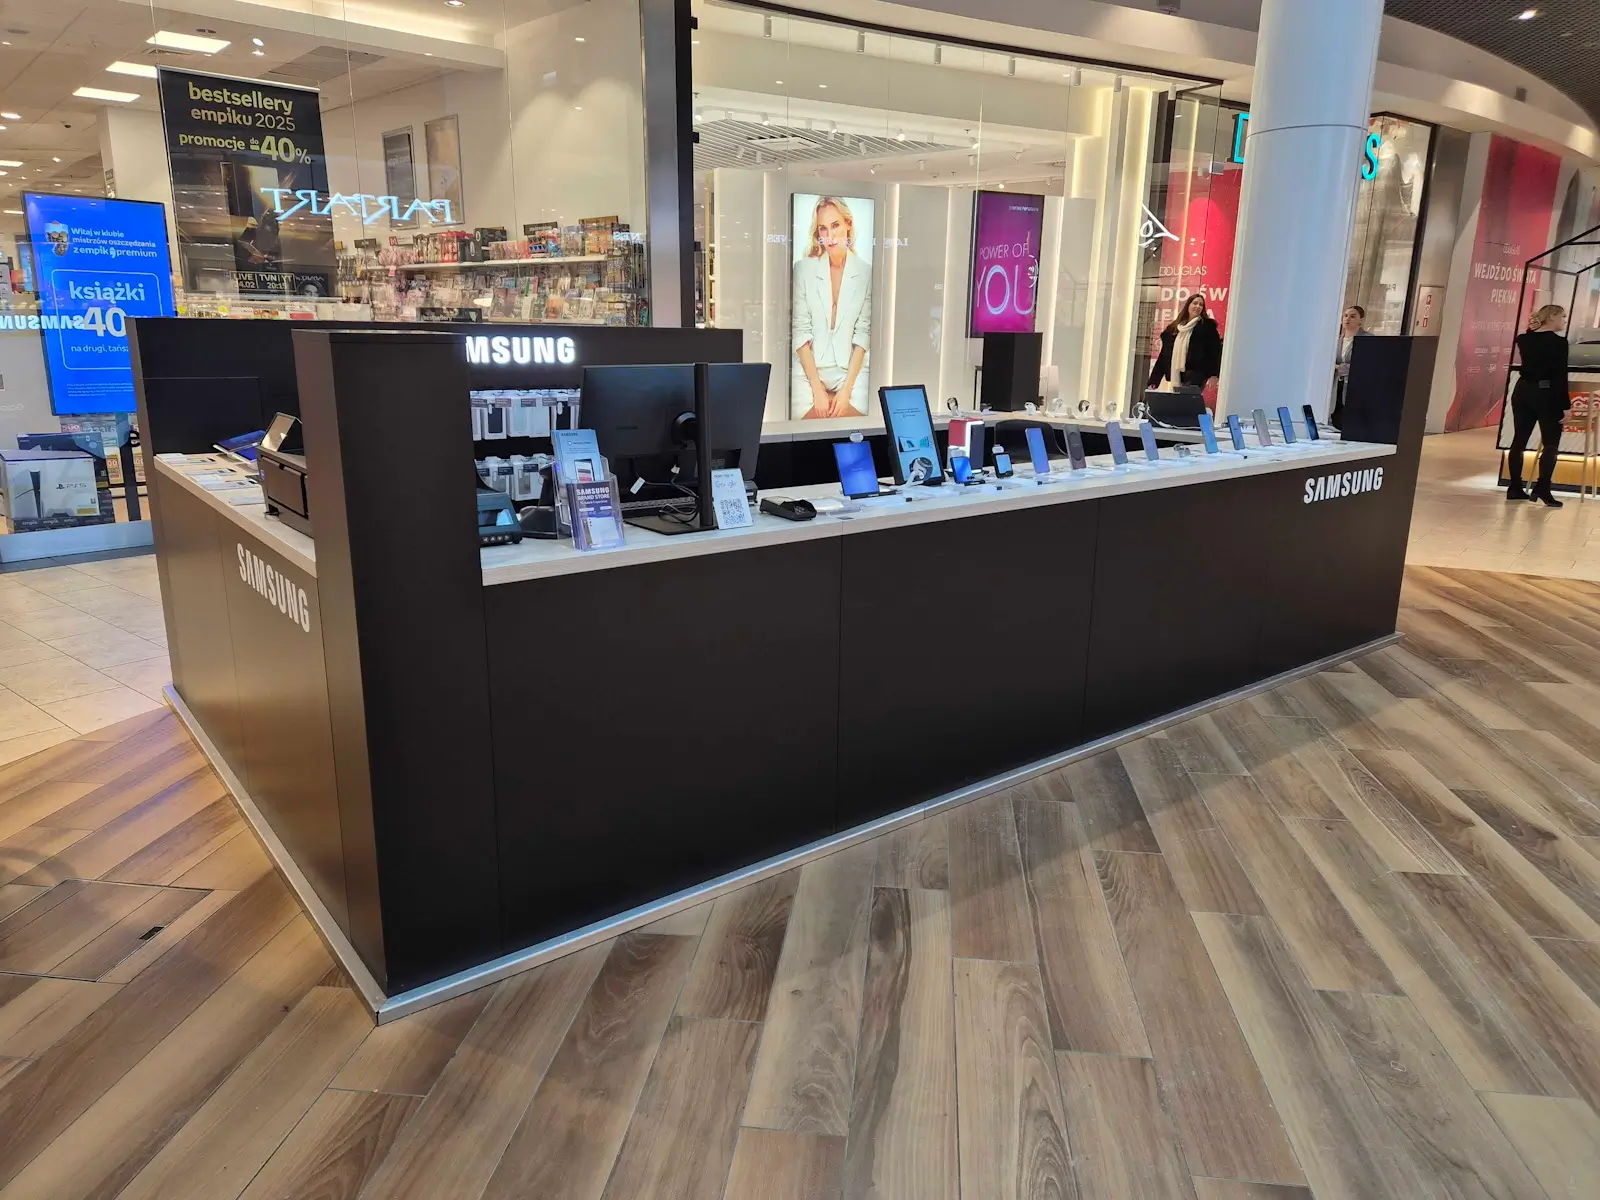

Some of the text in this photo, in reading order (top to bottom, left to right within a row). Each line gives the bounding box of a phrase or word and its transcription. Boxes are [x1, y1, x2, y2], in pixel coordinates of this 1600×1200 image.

[188, 81, 293, 115] bestsellery
[191, 107, 296, 132] empiku 2025
[179, 133, 246, 152] promocje
[71, 227, 93, 237] Witaj
[101, 229, 125, 238] klubie
[116, 248, 158, 258] premium
[979, 244, 1009, 261] POWER
[233, 273, 253, 281] LIVE
[1158, 265, 1208, 277] DOUGLAS
[1473, 262, 1501, 280] WEJDŹ
[1501, 266, 1512, 281] DO
[68, 280, 146, 305] książki
[976, 264, 1036, 316] YOU
[1160, 287, 1190, 302] DO
[576, 486, 610, 496] SAMSUNG
[1303, 466, 1384, 505] SAMSUNG
[237, 542, 310, 633] SAMSUNG
